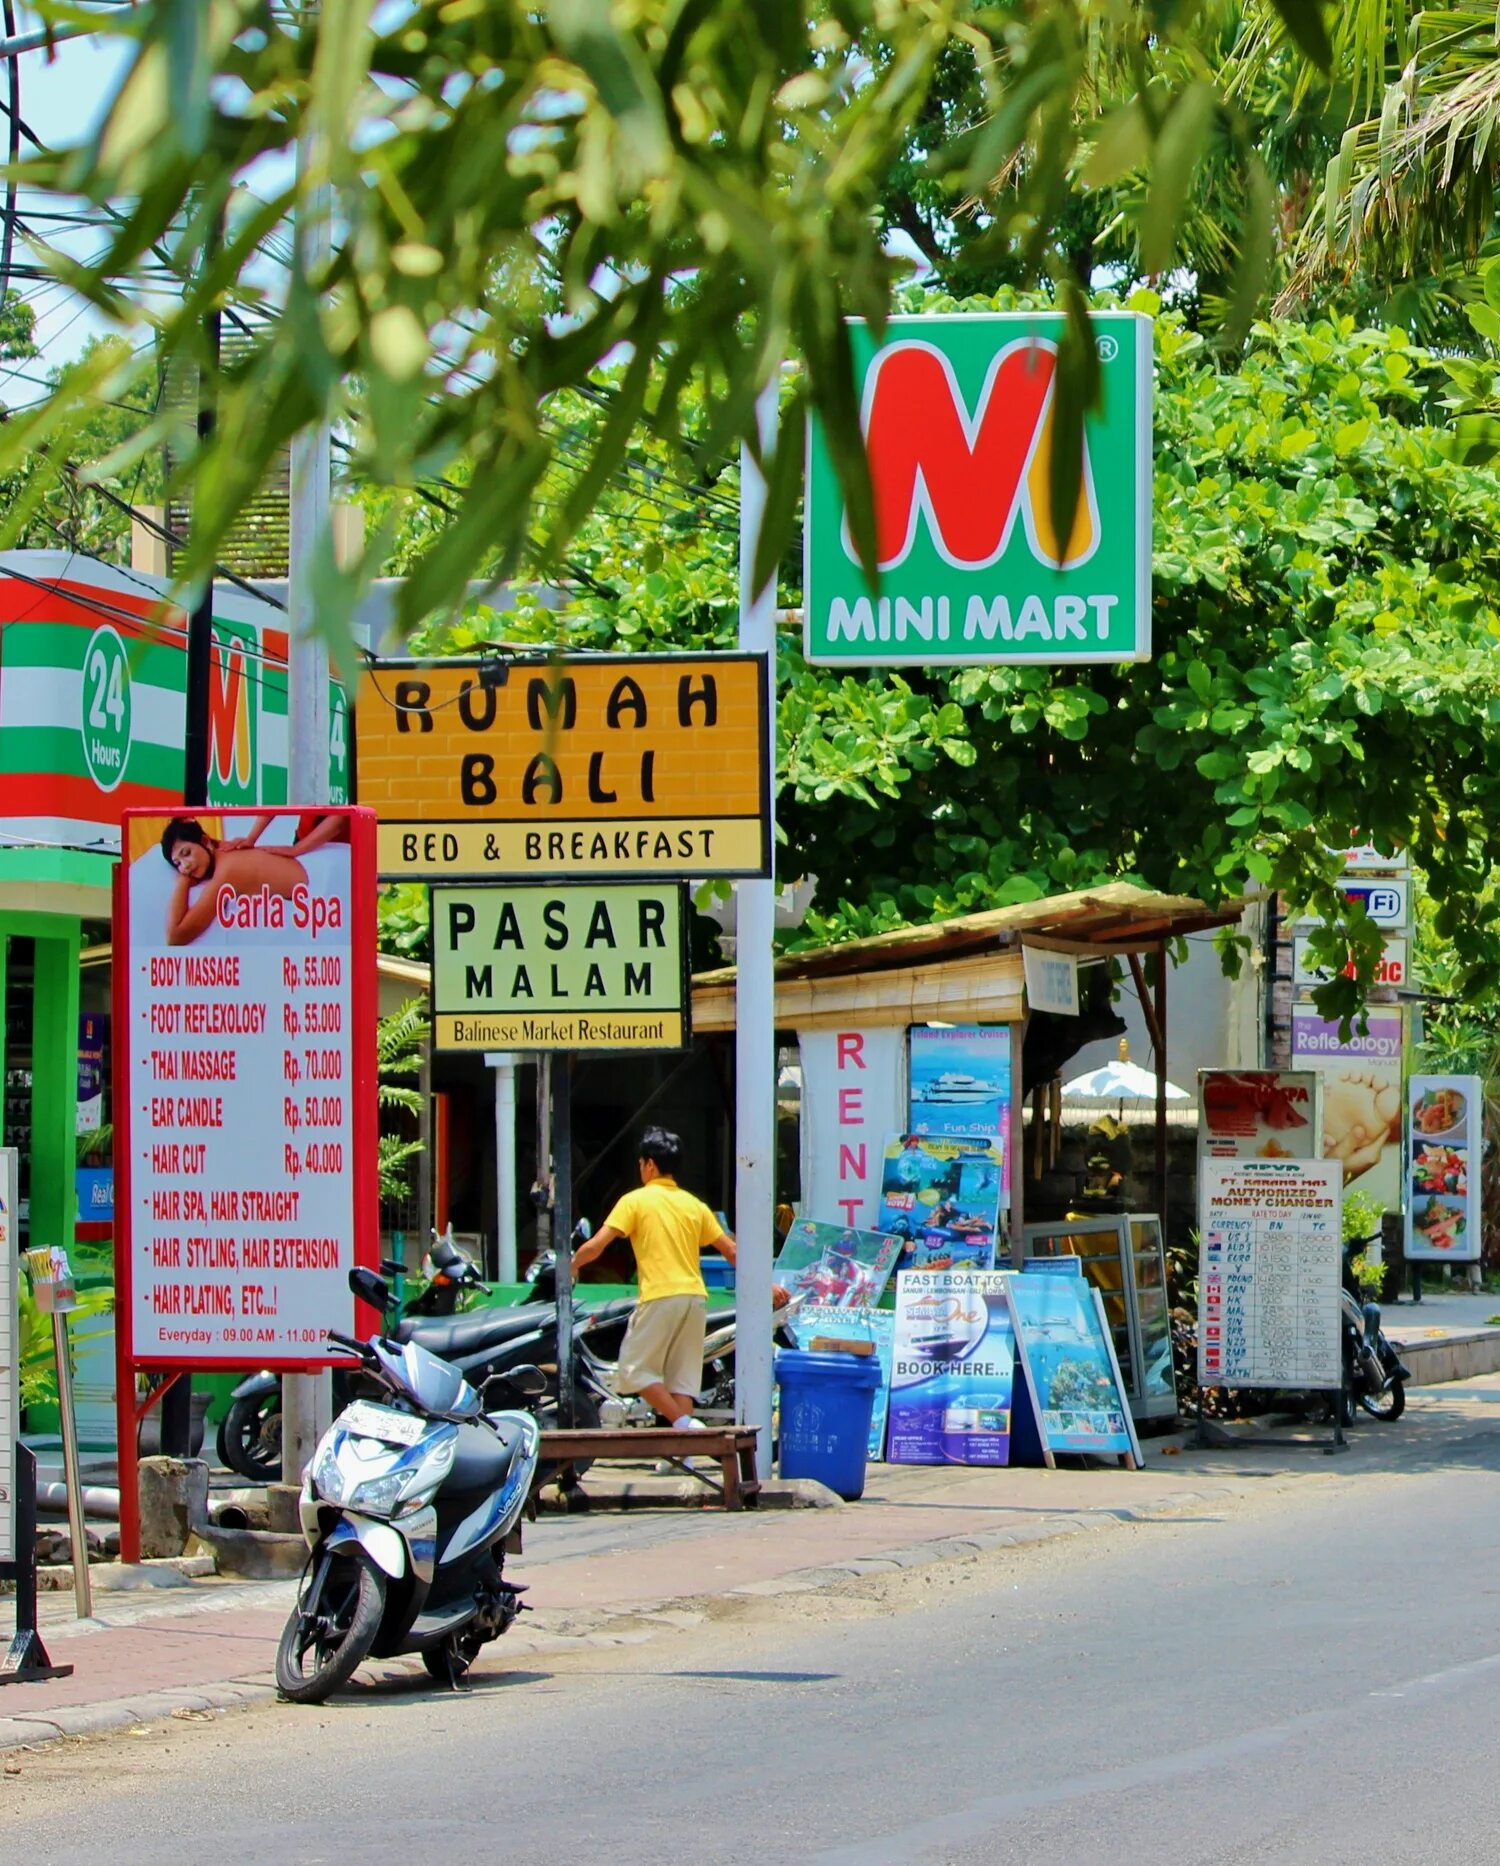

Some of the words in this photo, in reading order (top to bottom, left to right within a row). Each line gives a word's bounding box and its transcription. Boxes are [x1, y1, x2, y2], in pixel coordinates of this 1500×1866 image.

[826, 596, 950, 642] MINI
[963, 595, 1118, 641] MART
[89, 649, 125, 733] 24
[395, 674, 718, 733] RUMAH
[329, 700, 346, 772] 4
[91, 738, 121, 767] Hours
[460, 750, 655, 806] BALI
[402, 833, 459, 862] BED
[483, 832, 501, 861] &
[525, 830, 715, 861] BREAKFAST
[216, 883, 284, 929] Carla
[292, 884, 342, 939] Spa
[1374, 894, 1394, 911] Fi
[448, 899, 666, 951] PASAR
[151, 956, 181, 987] BODY
[185, 957, 240, 987] MASSAGE
[283, 957, 301, 993] Rp.
[304, 956, 341, 987] 55.000
[465, 962, 652, 999] MALAM
[151, 1003, 181, 1034] FOOT
[184, 1004, 267, 1034] REFLEXOLOGY
[283, 1003, 301, 1040] Rp.
[304, 1003, 342, 1034] 55.000
[454, 1021, 518, 1042] Balinese
[523, 1020, 573, 1041] Market
[579, 1020, 664, 1041] Restaurant
[151, 1050, 179, 1081] THAI
[181, 1051, 237, 1081] MASSAGE
[283, 1050, 301, 1087] Rp.
[305, 1049, 342, 1080] 70.000
[152, 1097, 175, 1128] EAR
[177, 1098, 223, 1128] CANDLE
[284, 1097, 302, 1134] Rp.
[305, 1097, 342, 1127] 50.000
[836, 1031, 867, 1228] RENT
[944, 1123, 966, 1132] Fun
[969, 1122, 996, 1134] Ship
[152, 1144, 181, 1174] HAIR
[183, 1145, 206, 1174] CUT
[284, 1144, 302, 1181] Rp.
[305, 1144, 343, 1174] 40.000
[152, 1191, 181, 1221] HAIR
[183, 1191, 208, 1226] SPA,
[211, 1191, 239, 1221] HAIR
[241, 1192, 299, 1222] STRAIGHT
[1211, 1198, 1261, 1206] MONEY
[1265, 1199, 1334, 1207] CHANGER
[1227, 1188, 1317, 1197] AUTHORIZED
[1211, 1221, 1252, 1230] CURRENCY
[1269, 1222, 1283, 1230] BN
[153, 1238, 180, 1268] HAIR
[187, 1238, 240, 1274] STYLING,
[243, 1239, 271, 1268] HAIR
[273, 1239, 339, 1269] EXTENSION
[1227, 1254, 1251, 1263] EURO
[904, 1275, 940, 1286] FAST
[943, 1275, 981, 1286] BOAT
[984, 1275, 1004, 1286] TO
[1227, 1275, 1253, 1283] POUND
[1227, 1285, 1246, 1293] CAN
[153, 1285, 181, 1314] HAIR
[184, 1285, 235, 1321] PLATING,
[1226, 1306, 1245, 1315] MAL
[1227, 1296, 1241, 1304] HK
[158, 1327, 212, 1345] Everyday
[223, 1328, 253, 1342] 09.00
[256, 1328, 275, 1342] AM
[287, 1328, 315, 1342] 11.00
[1226, 1338, 1245, 1346] NZD
[1226, 1348, 1246, 1356] RMB
[897, 1362, 944, 1375] BOOK
[950, 1363, 1009, 1376] HERE...
